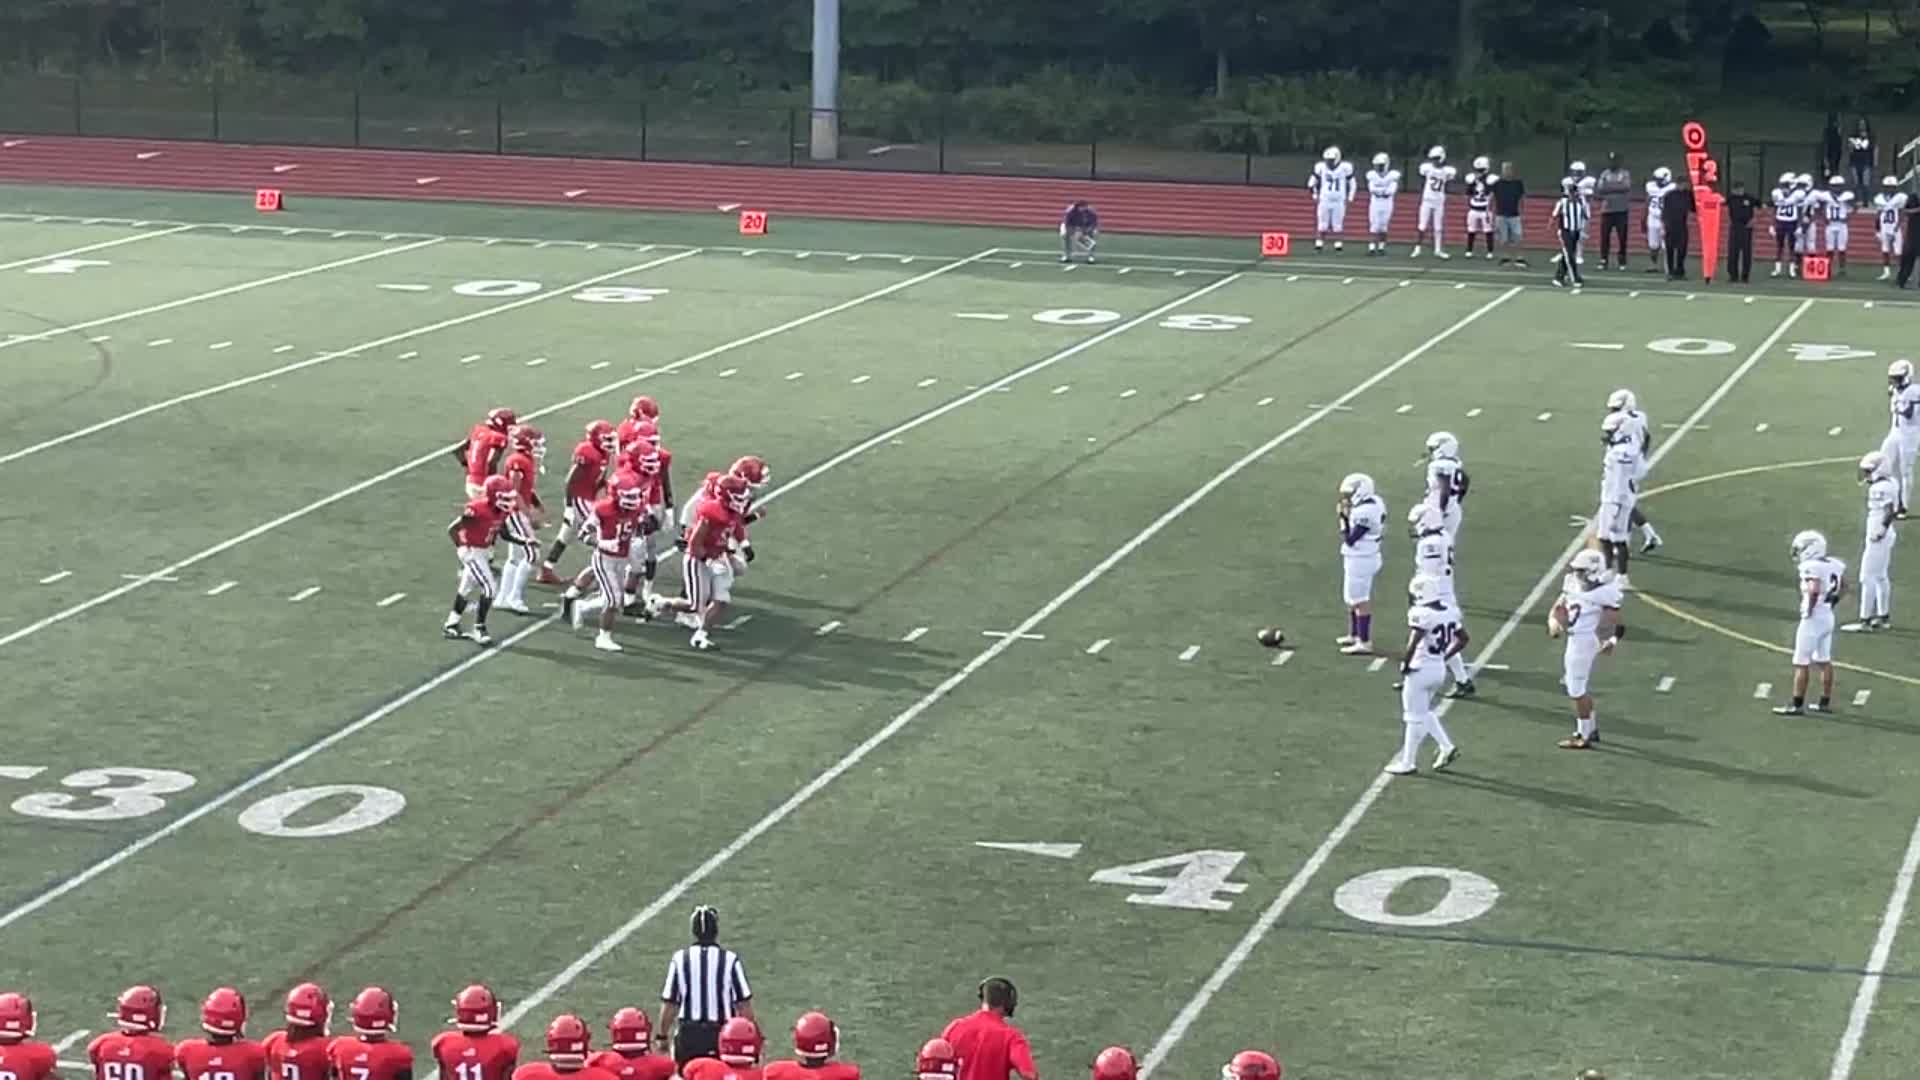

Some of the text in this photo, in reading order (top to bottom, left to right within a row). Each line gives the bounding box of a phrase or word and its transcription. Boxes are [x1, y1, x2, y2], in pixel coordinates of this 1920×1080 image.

[744, 215, 763, 230] 20
[1264, 235, 1285, 251] 30
[1806, 260, 1827, 276] 40
